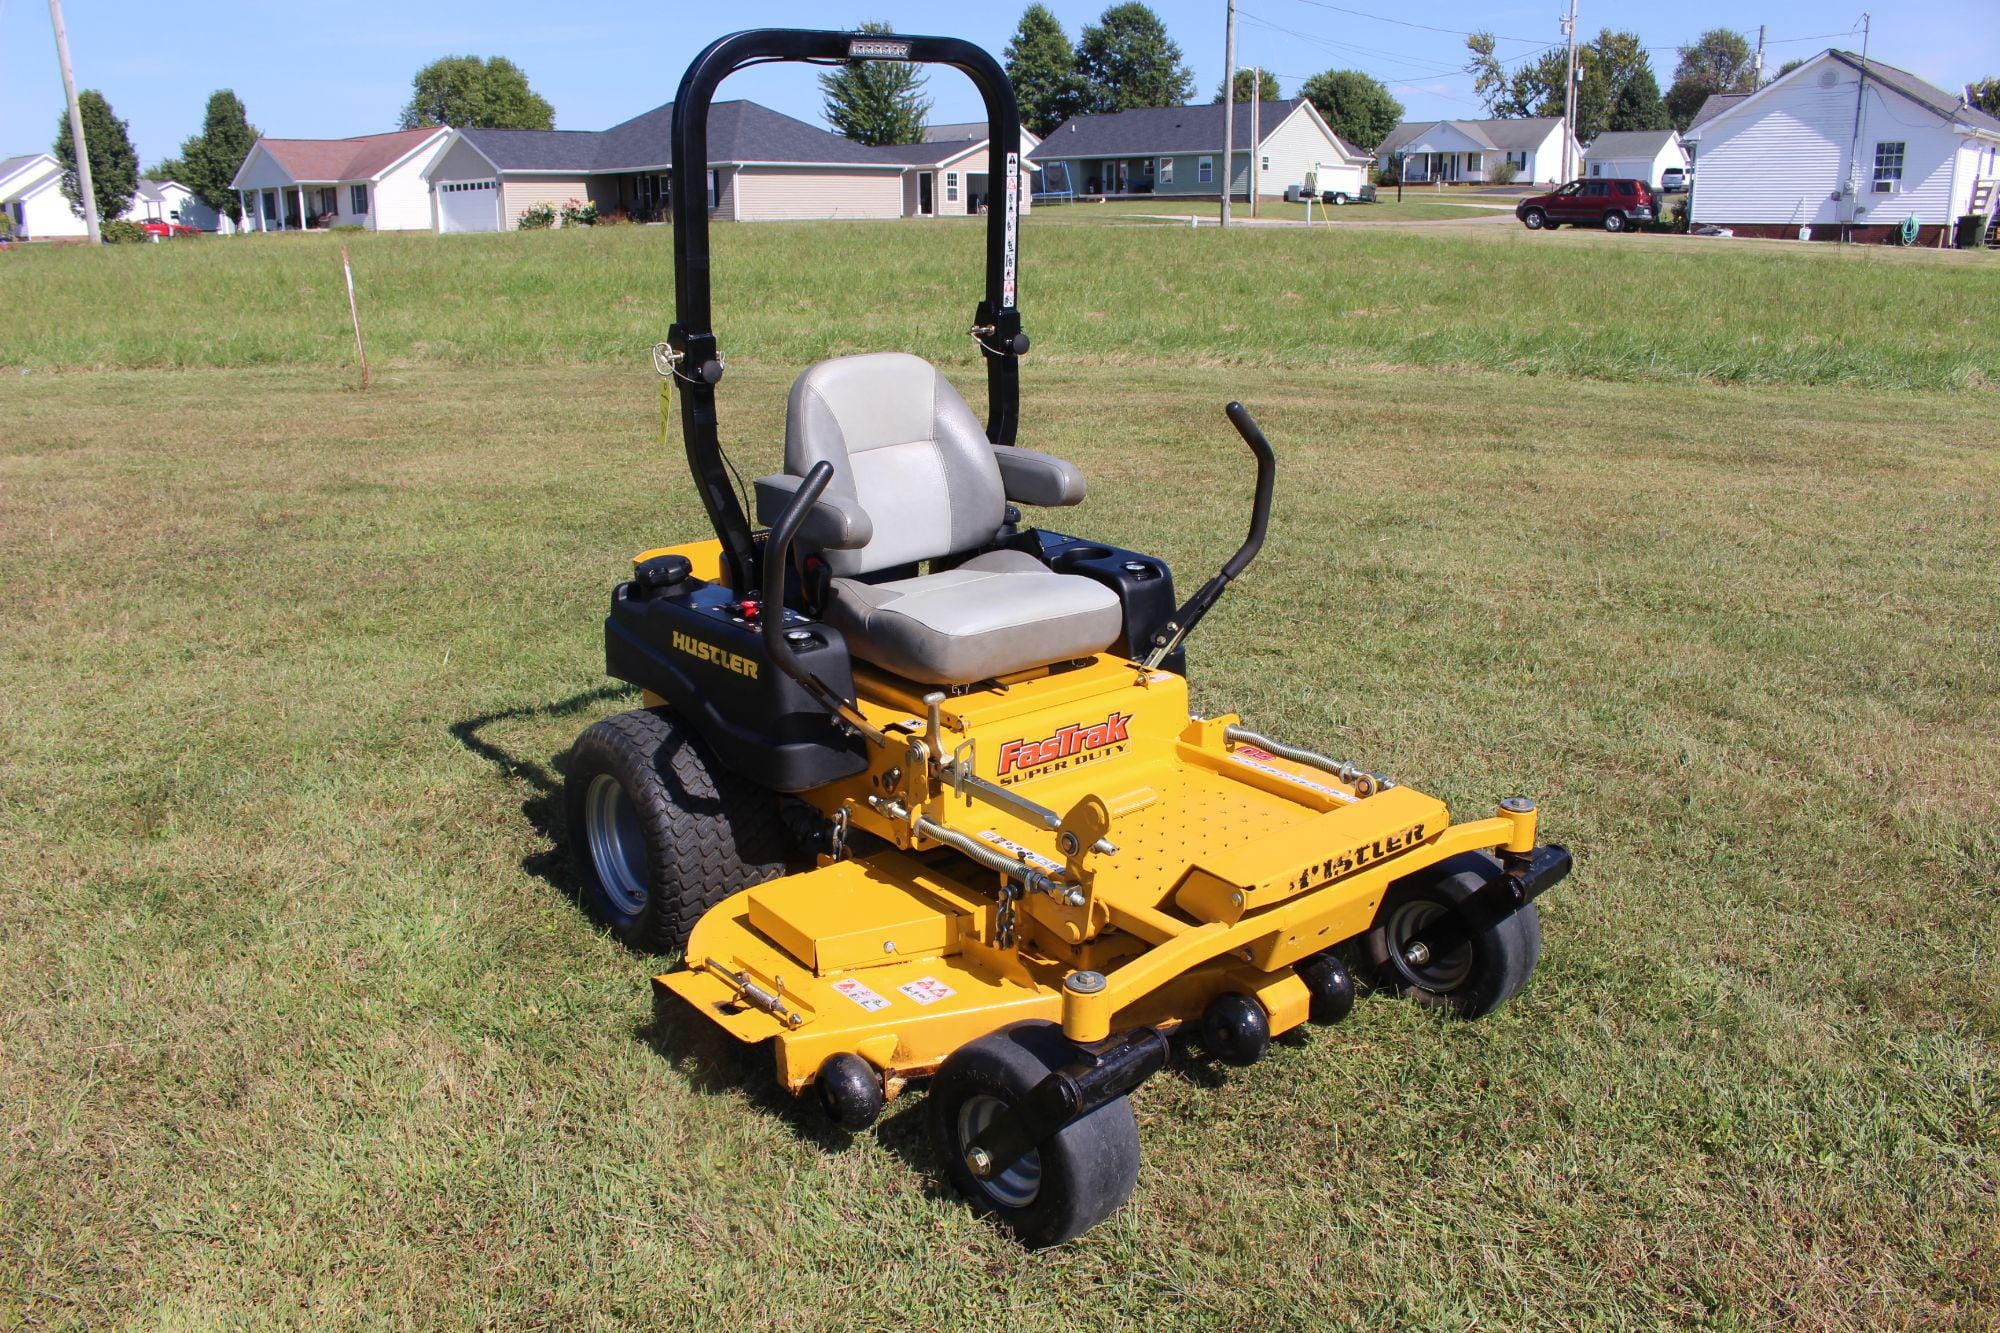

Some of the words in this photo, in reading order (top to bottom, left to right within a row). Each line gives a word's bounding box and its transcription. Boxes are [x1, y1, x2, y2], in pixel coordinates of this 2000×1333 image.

[672, 630, 758, 680] HUSTLER
[997, 711, 1133, 776] FasTrak
[1000, 760, 1067, 785] SUPER
[1075, 743, 1128, 765] DUTY
